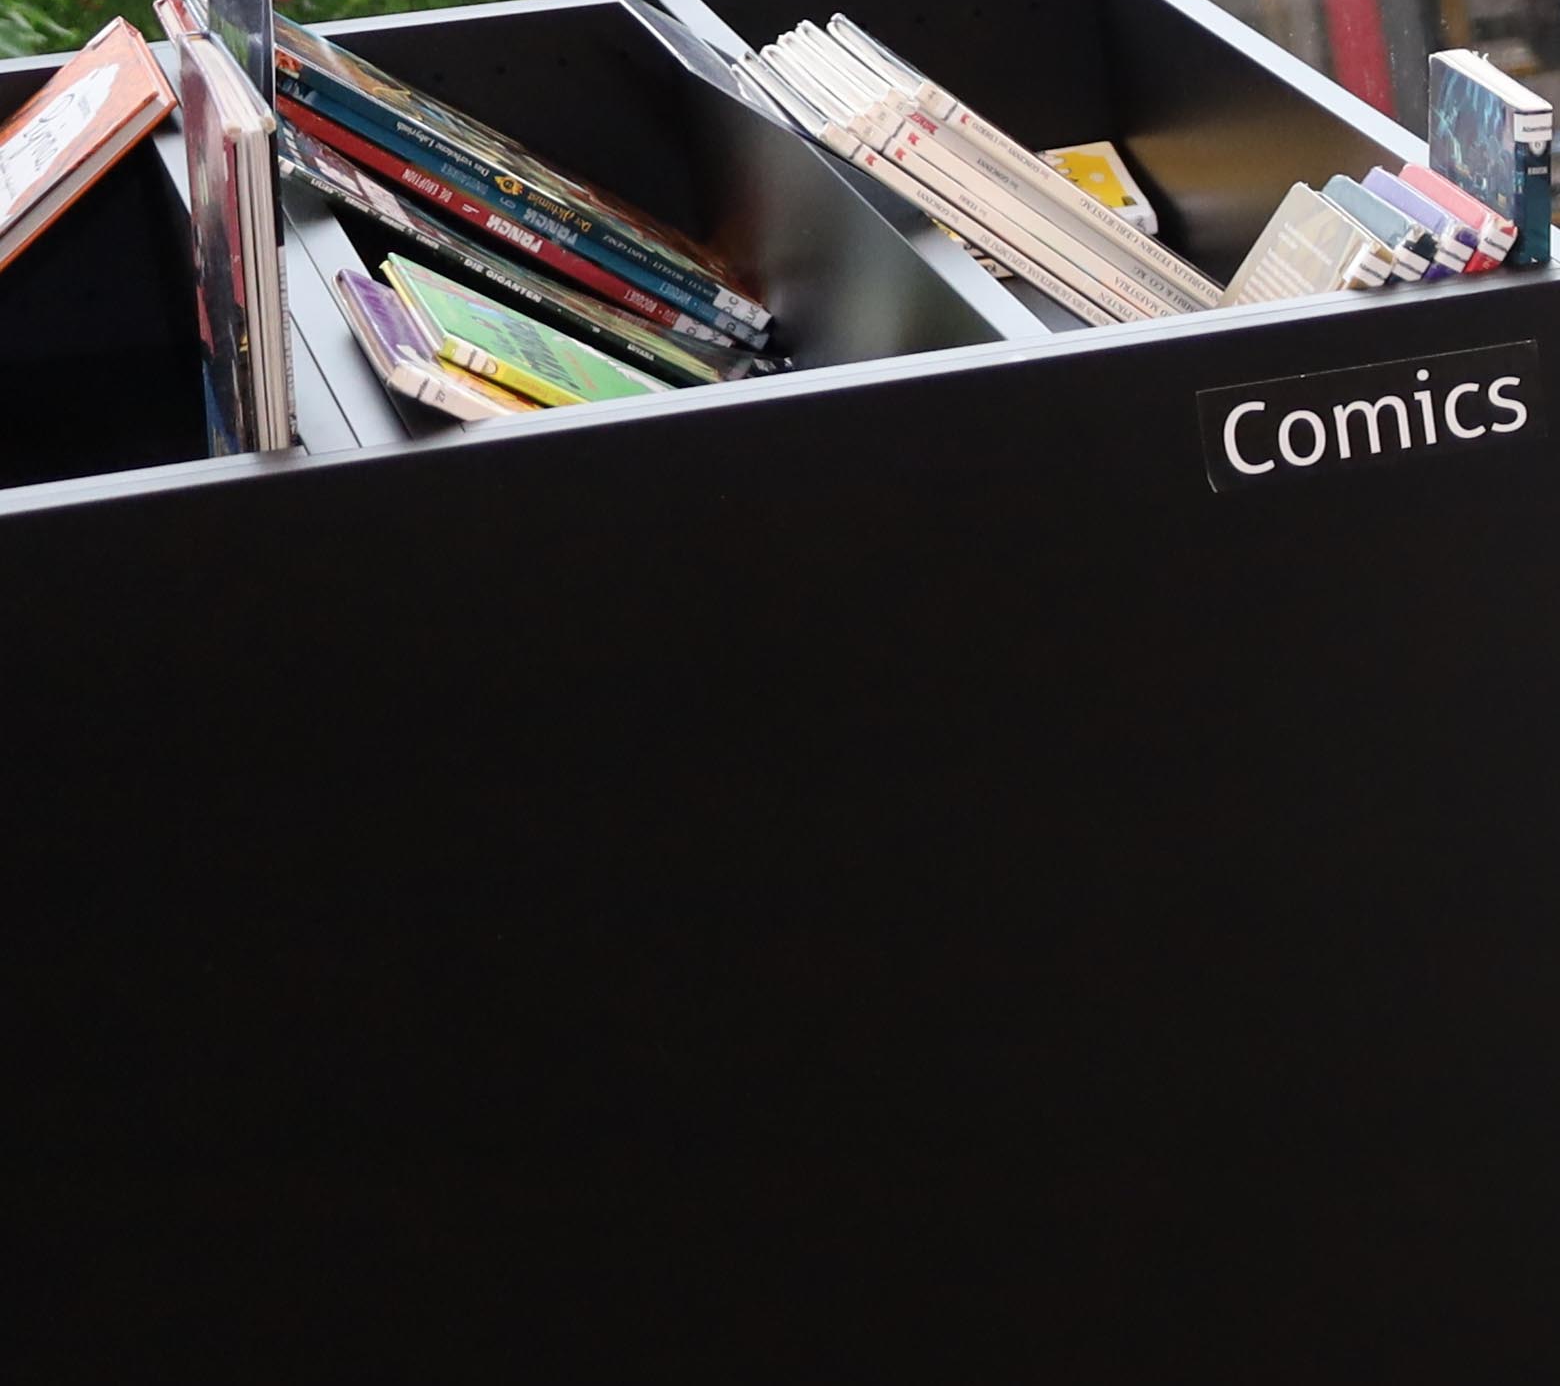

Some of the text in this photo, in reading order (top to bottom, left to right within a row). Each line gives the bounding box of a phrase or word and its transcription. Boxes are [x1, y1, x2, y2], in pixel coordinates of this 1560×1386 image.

[484, 212, 544, 254] FRNCK
[464, 258, 543, 305] DIE GIGANTEN
[1222, 370, 1528, 476] Comics
